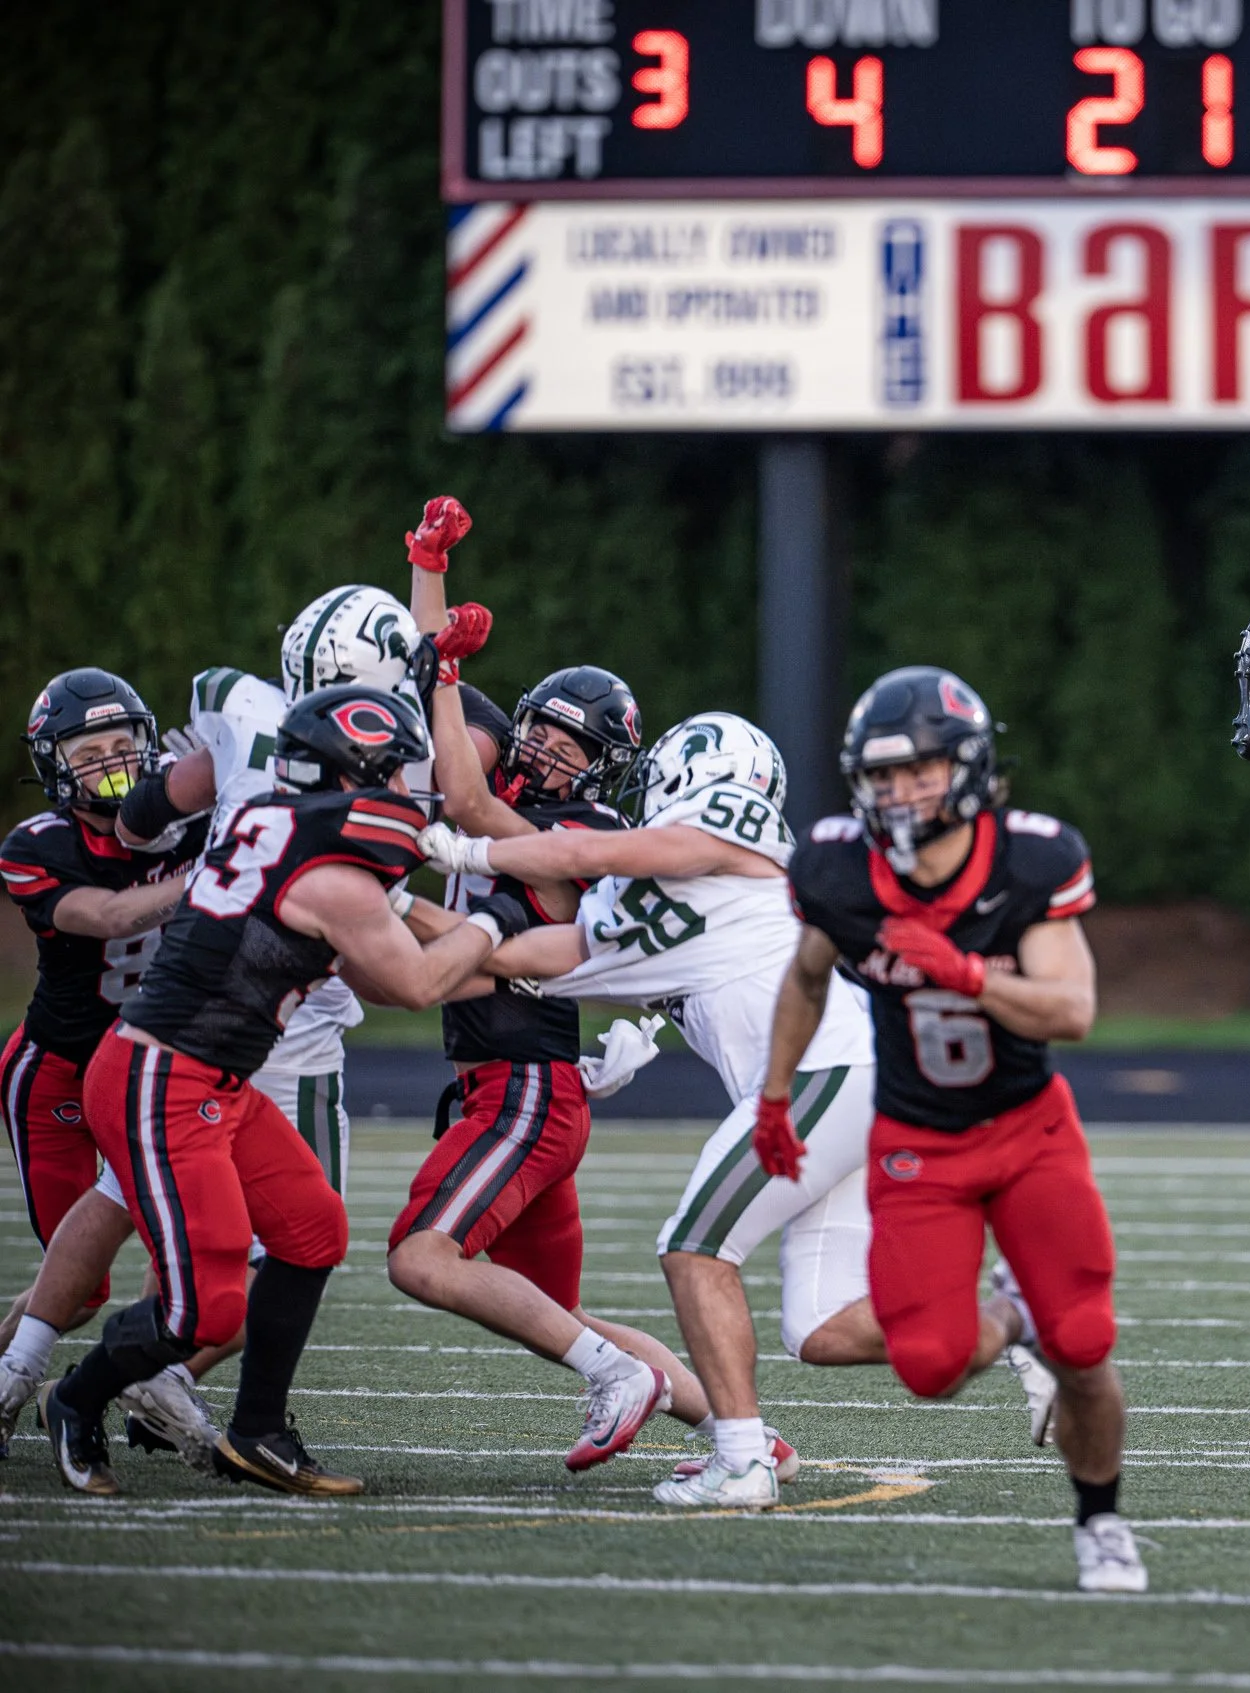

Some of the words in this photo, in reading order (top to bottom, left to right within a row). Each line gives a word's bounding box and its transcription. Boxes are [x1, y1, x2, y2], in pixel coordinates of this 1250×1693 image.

[475, 48, 622, 112] OUTS
[632, 29, 690, 129] 3
[806, 55, 884, 168] 4
[479, 116, 612, 180] LEFT
[550, 699, 584, 719] Riddell
[701, 791, 771, 844] 58
[188, 801, 298, 921] 3
[904, 987, 994, 1088] 6
